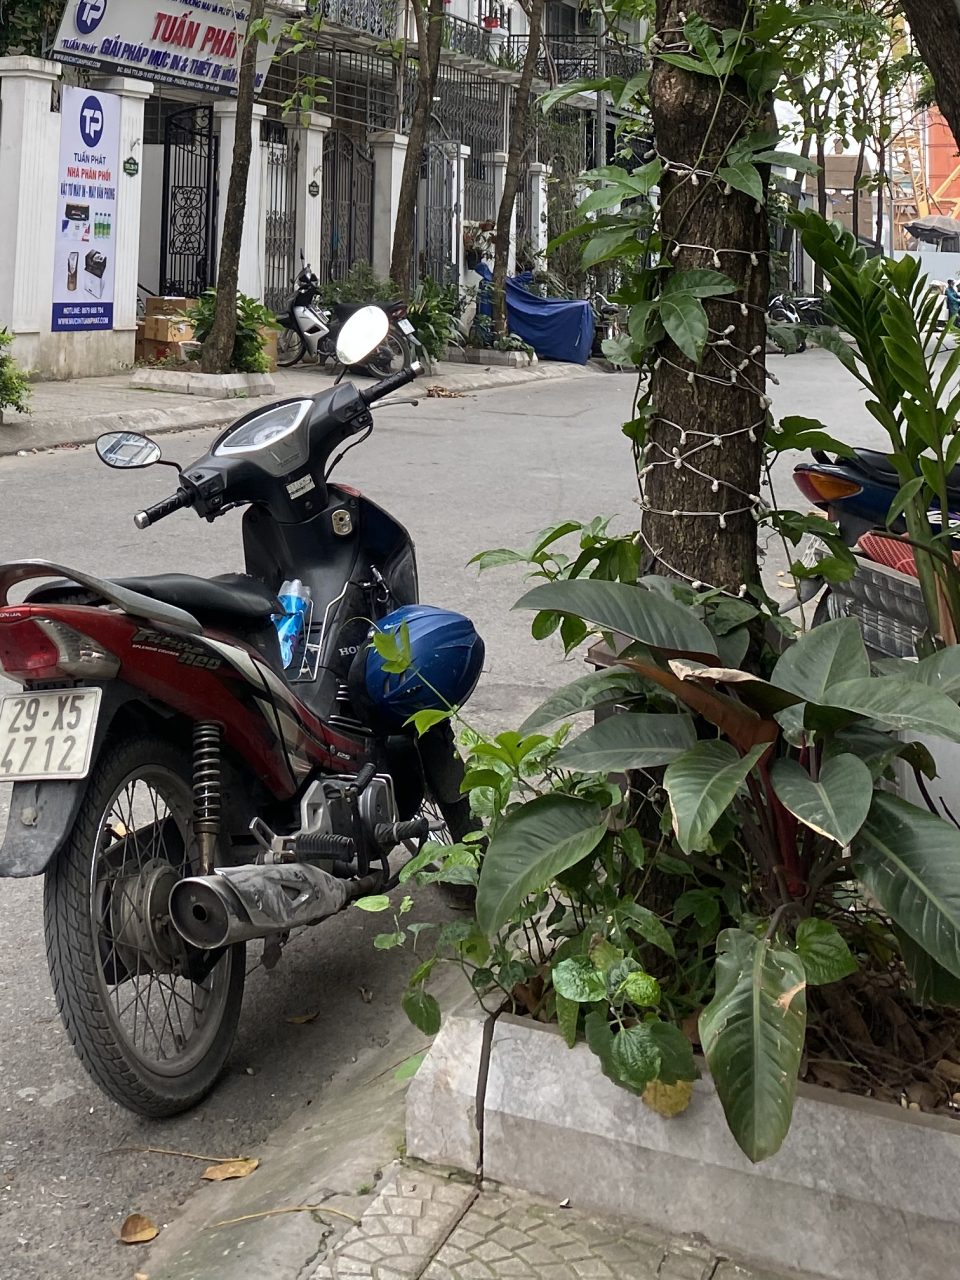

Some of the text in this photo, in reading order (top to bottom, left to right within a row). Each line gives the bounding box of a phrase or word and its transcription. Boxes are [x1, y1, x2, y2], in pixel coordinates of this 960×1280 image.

[62, 37, 98, 55] TUẤN PHÁT
[152, 10, 244, 59] TUẤN PHÁT
[100, 34, 121, 58] GIẢI
[120, 42, 149, 65] PHÁP
[147, 47, 171, 70] MỰC
[169, 54, 182, 70] IN
[179, 56, 189, 73] &
[189, 57, 213, 77] THIẾT
[74, 150, 90, 163] TUẤN
[7, 694, 85, 734] 29-X5
[0, 735, 77, 773] 4712
